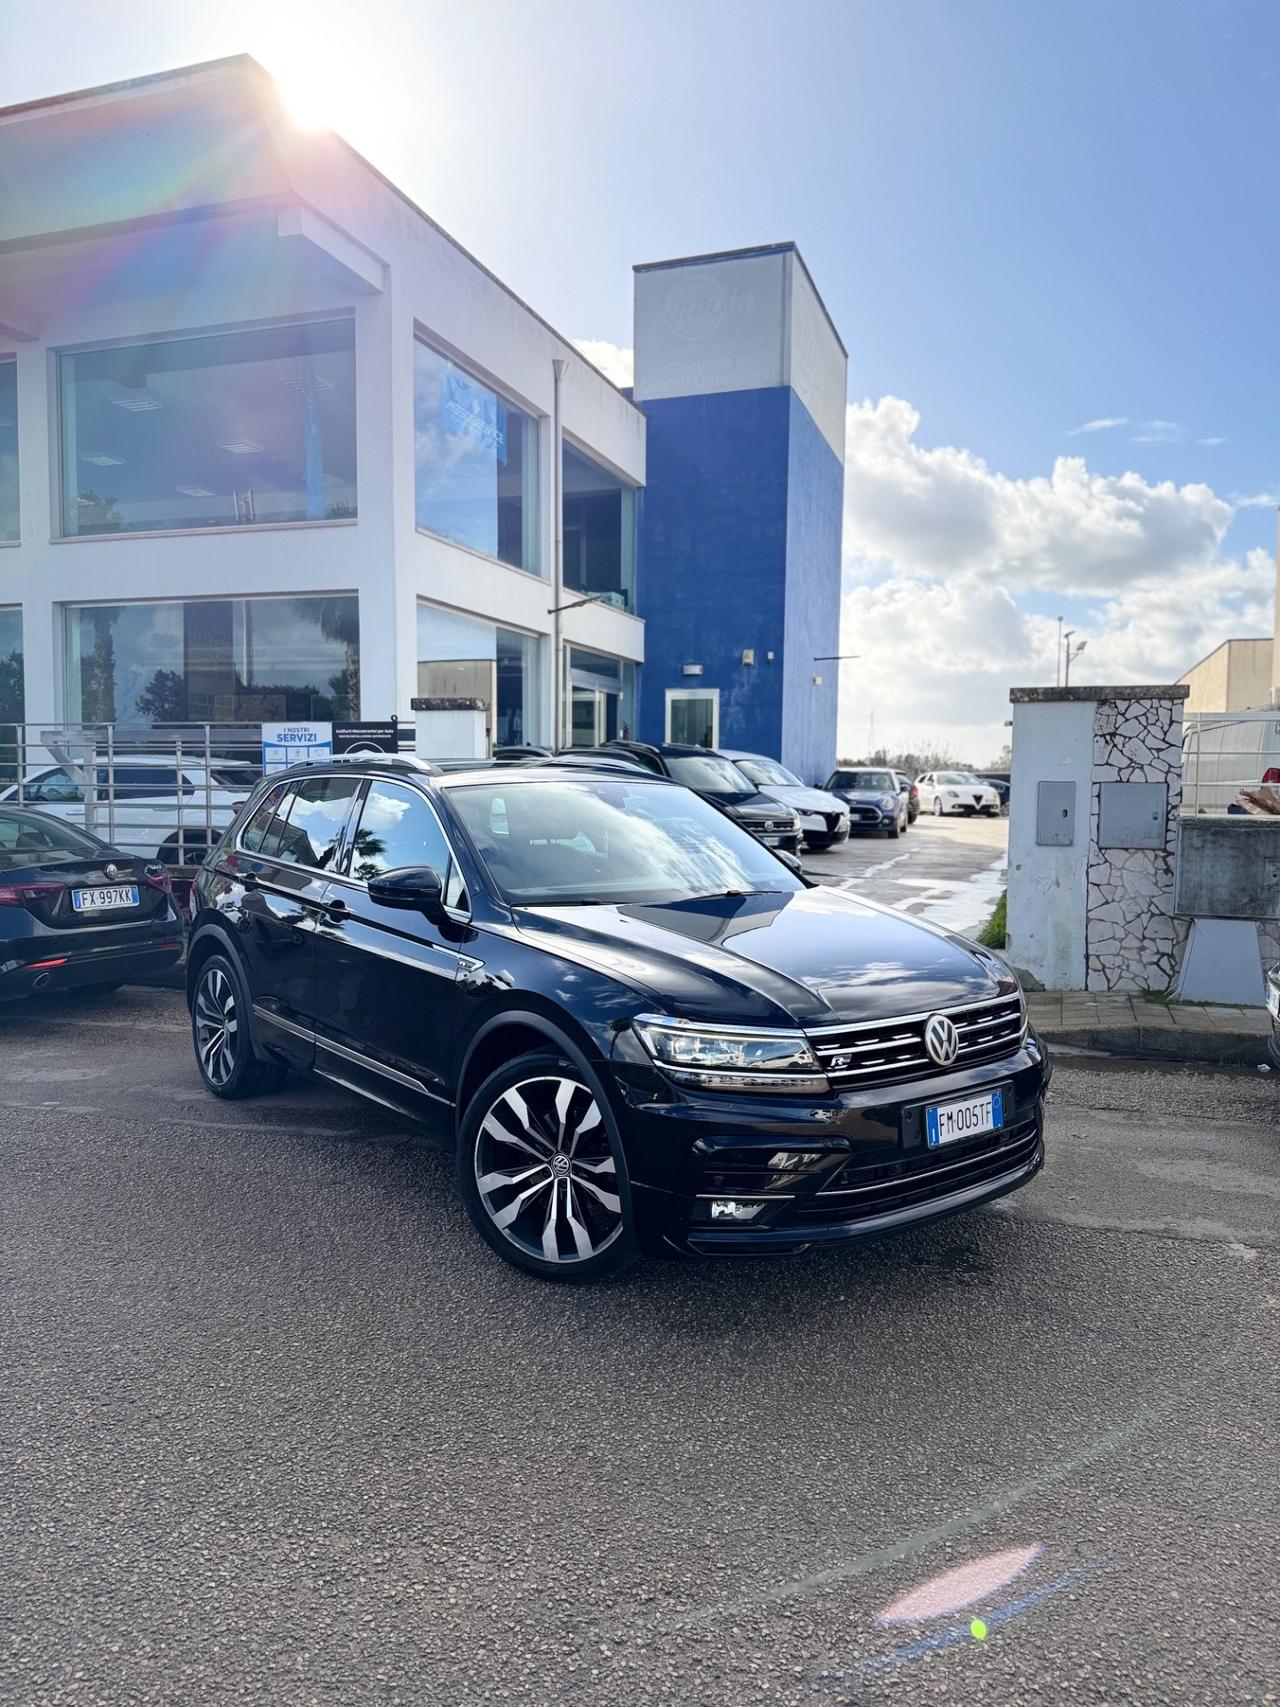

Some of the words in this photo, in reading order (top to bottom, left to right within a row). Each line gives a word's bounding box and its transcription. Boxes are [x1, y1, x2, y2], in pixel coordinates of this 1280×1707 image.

[276, 733, 317, 743] SERVIZI
[81, 891, 96, 907] FX
[98, 889, 132, 905] 997KK
